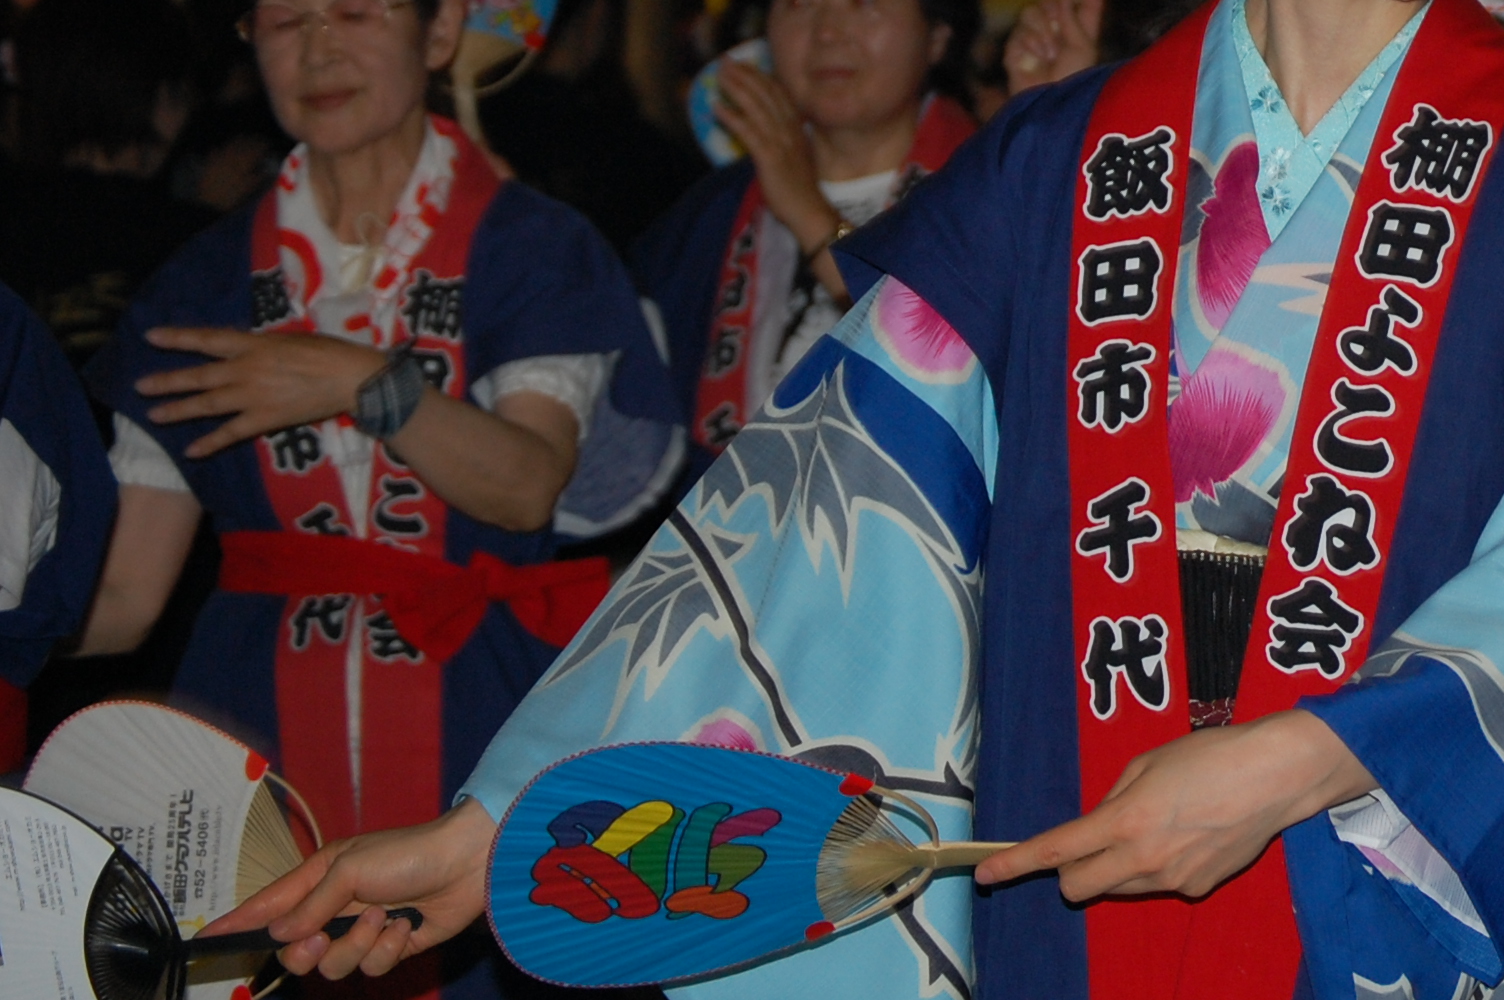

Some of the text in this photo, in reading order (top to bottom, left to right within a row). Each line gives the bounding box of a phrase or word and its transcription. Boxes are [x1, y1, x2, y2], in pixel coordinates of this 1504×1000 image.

[1266, 102, 1493, 680] 棚田よこね会
